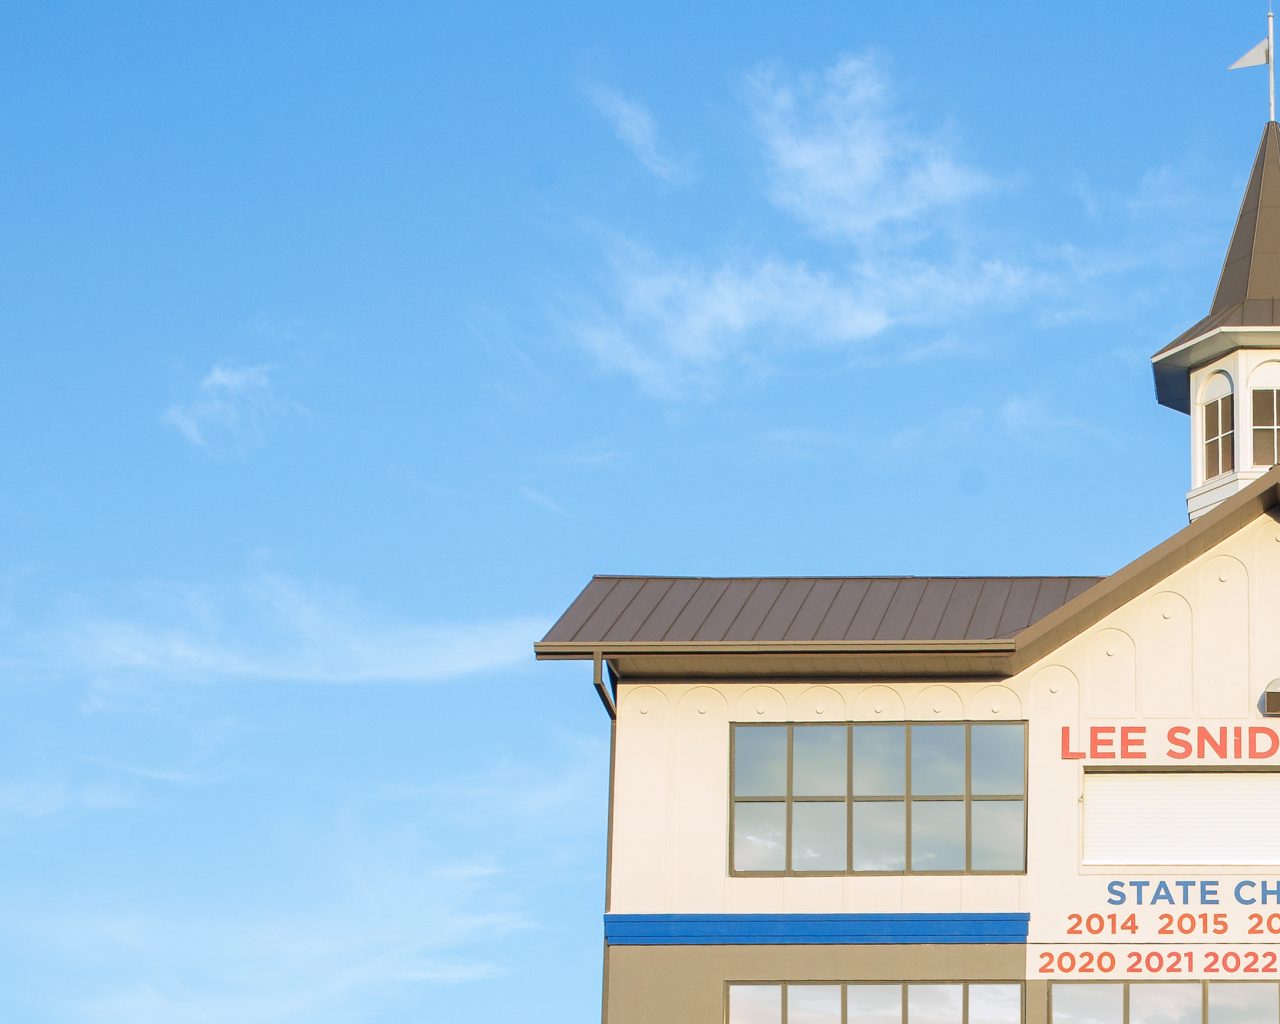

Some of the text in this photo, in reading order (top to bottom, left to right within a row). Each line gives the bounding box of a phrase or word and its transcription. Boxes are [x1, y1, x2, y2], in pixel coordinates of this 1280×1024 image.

[1062, 726, 1146, 759] LEE
[1107, 881, 1219, 905] STATE
[1067, 914, 1137, 934] 2014
[1159, 913, 1228, 934] 2015
[1040, 952, 1115, 973] 2020
[1127, 952, 1193, 973] 2021
[1204, 952, 1277, 973] 2022
